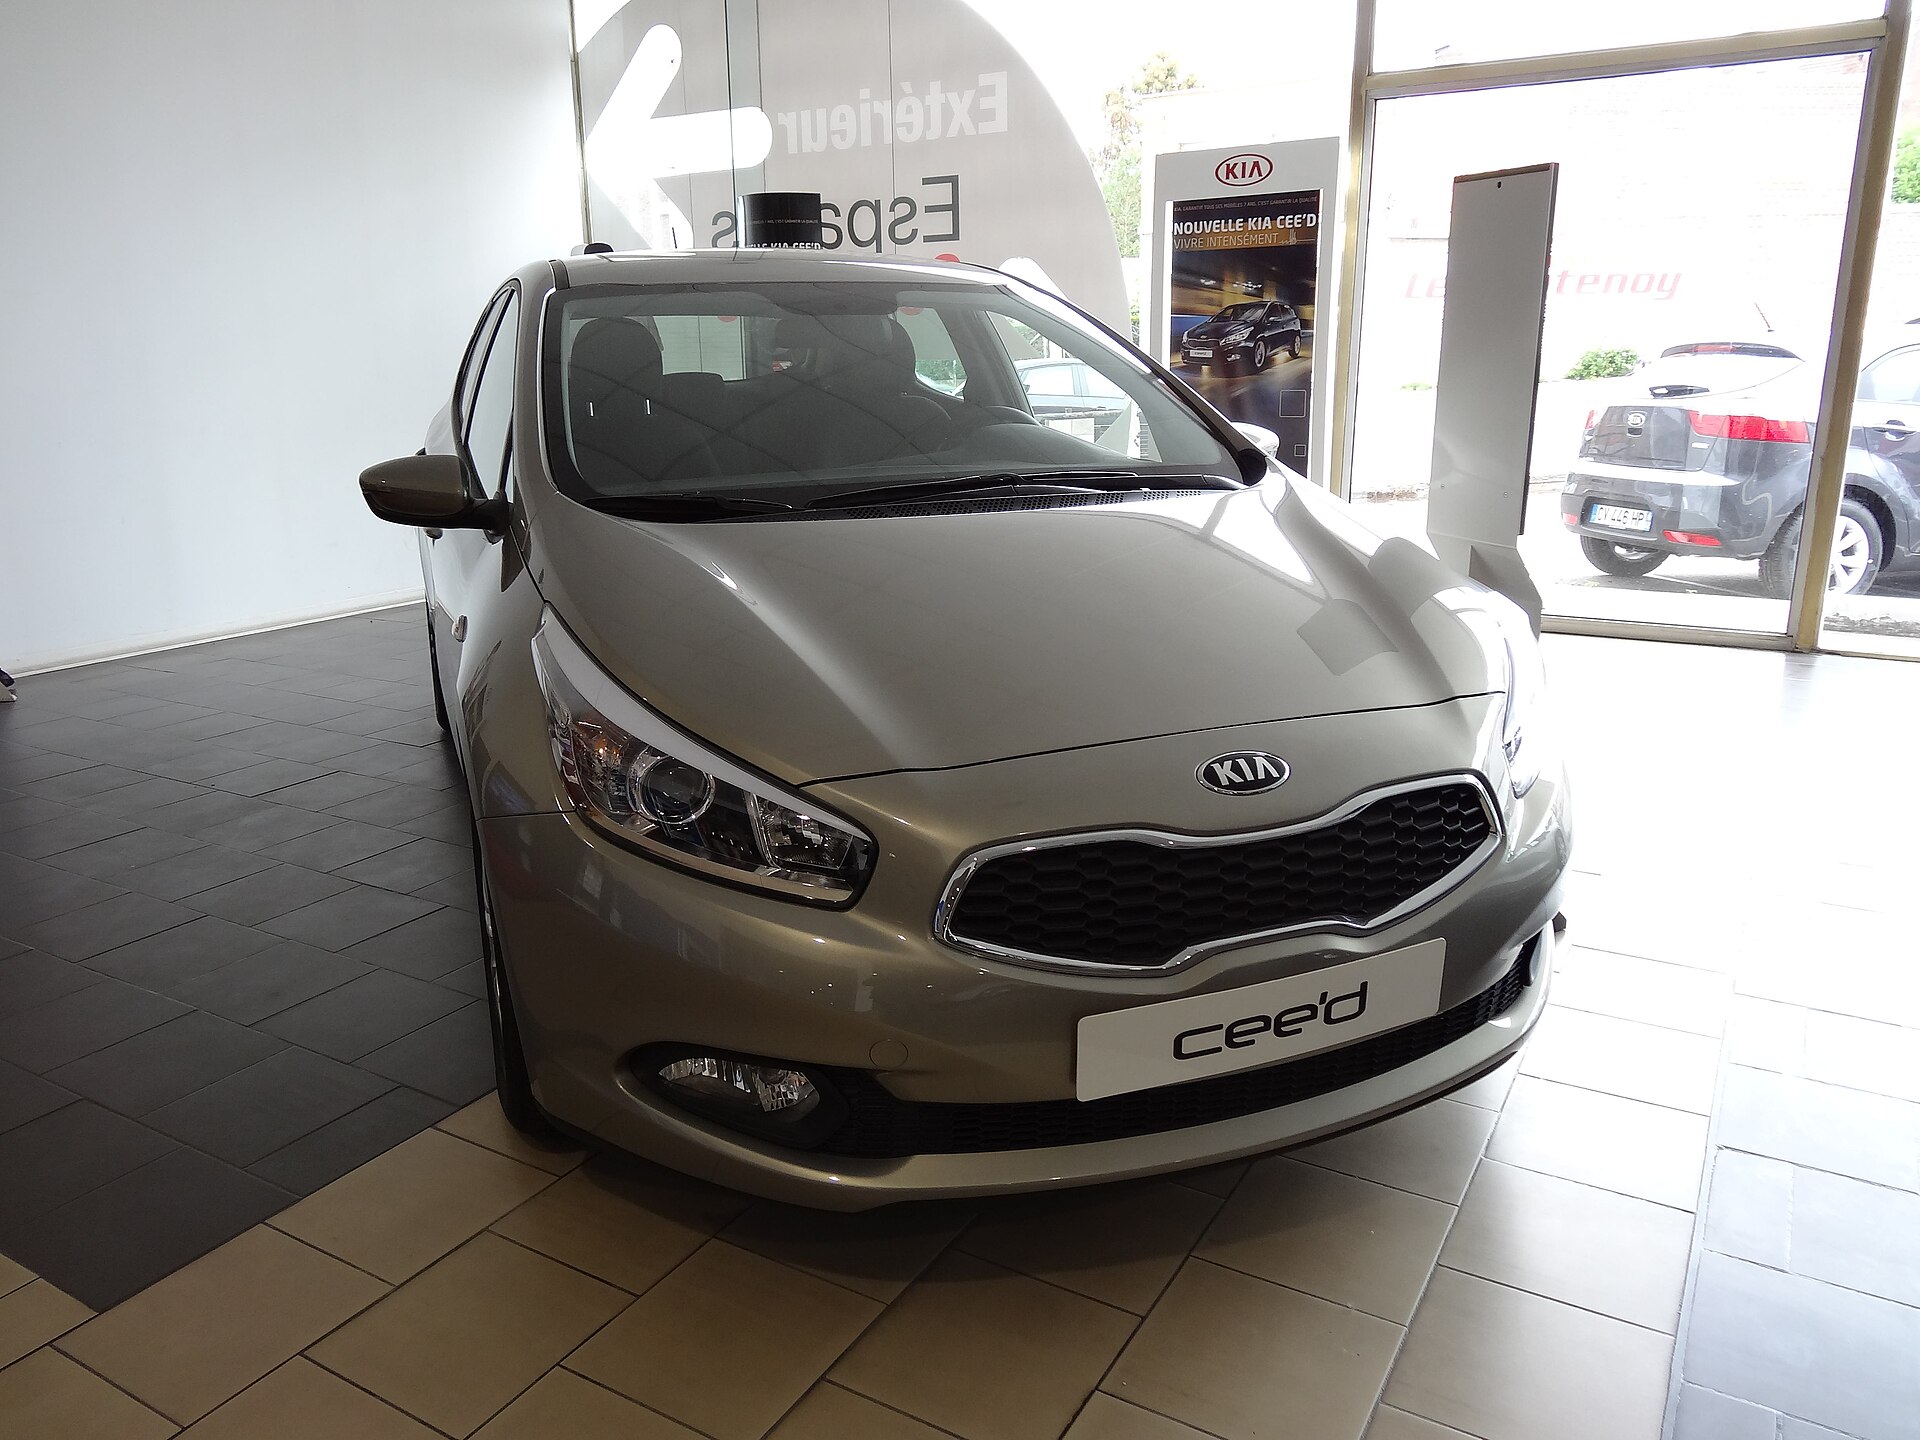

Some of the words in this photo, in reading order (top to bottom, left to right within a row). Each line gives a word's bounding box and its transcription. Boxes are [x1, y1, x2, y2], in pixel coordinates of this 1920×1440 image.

[1224, 160, 1264, 181] KIA
[1173, 218, 1244, 236] NOUVELLE
[1248, 216, 1272, 231] KIA
[1173, 237, 1204, 249] VIVRE
[1206, 232, 1279, 248] INTENSÉMENT
[1211, 756, 1281, 785] KIA
